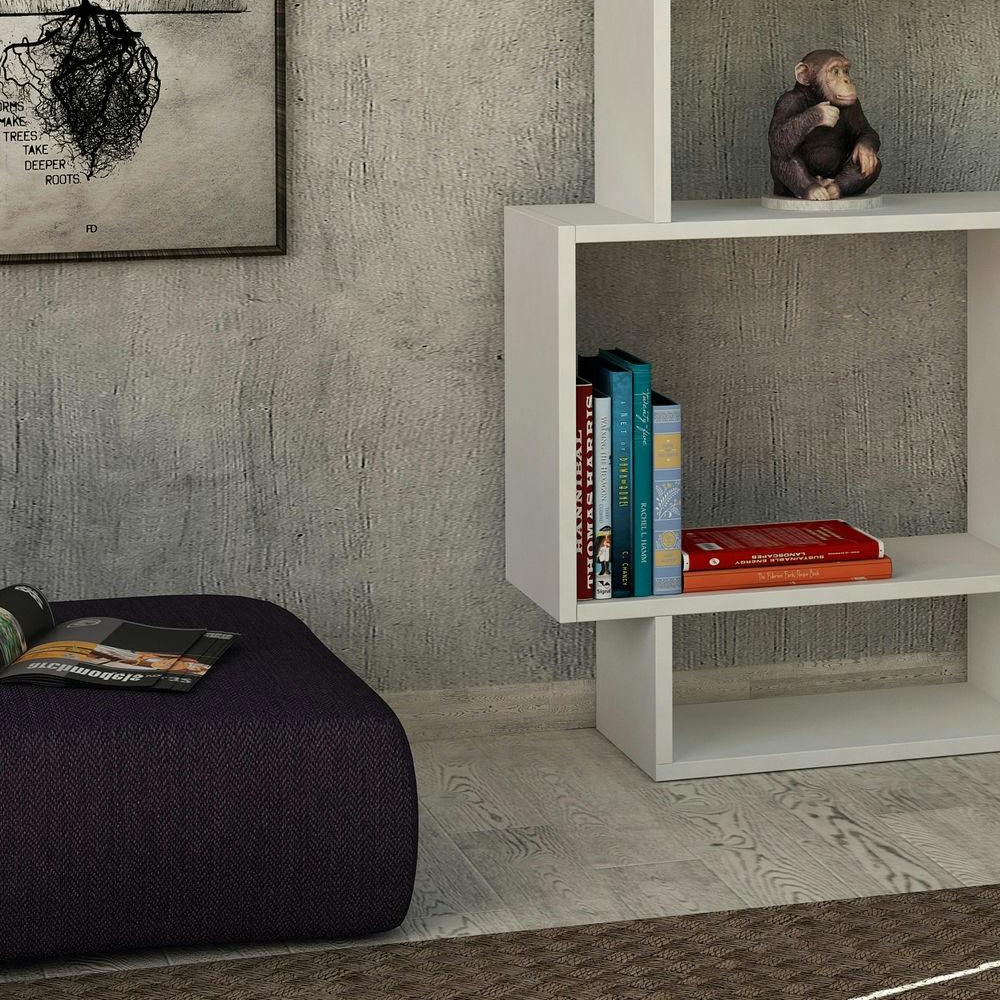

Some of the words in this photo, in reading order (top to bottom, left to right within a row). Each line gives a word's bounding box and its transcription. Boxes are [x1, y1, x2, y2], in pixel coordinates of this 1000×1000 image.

[3, 131, 38, 142] TREES
[23, 144, 49, 155] TAKE
[25, 159, 66, 171] DEEPER
[86, 224, 98, 233] FD
[640, 502, 648, 531] RACHEL
[640, 538, 648, 563] HAMM
[751, 551, 806, 560] LANDSCAPES
[734, 558, 774, 566] ENERGY
[774, 554, 825, 564] SUSTAINABLE
